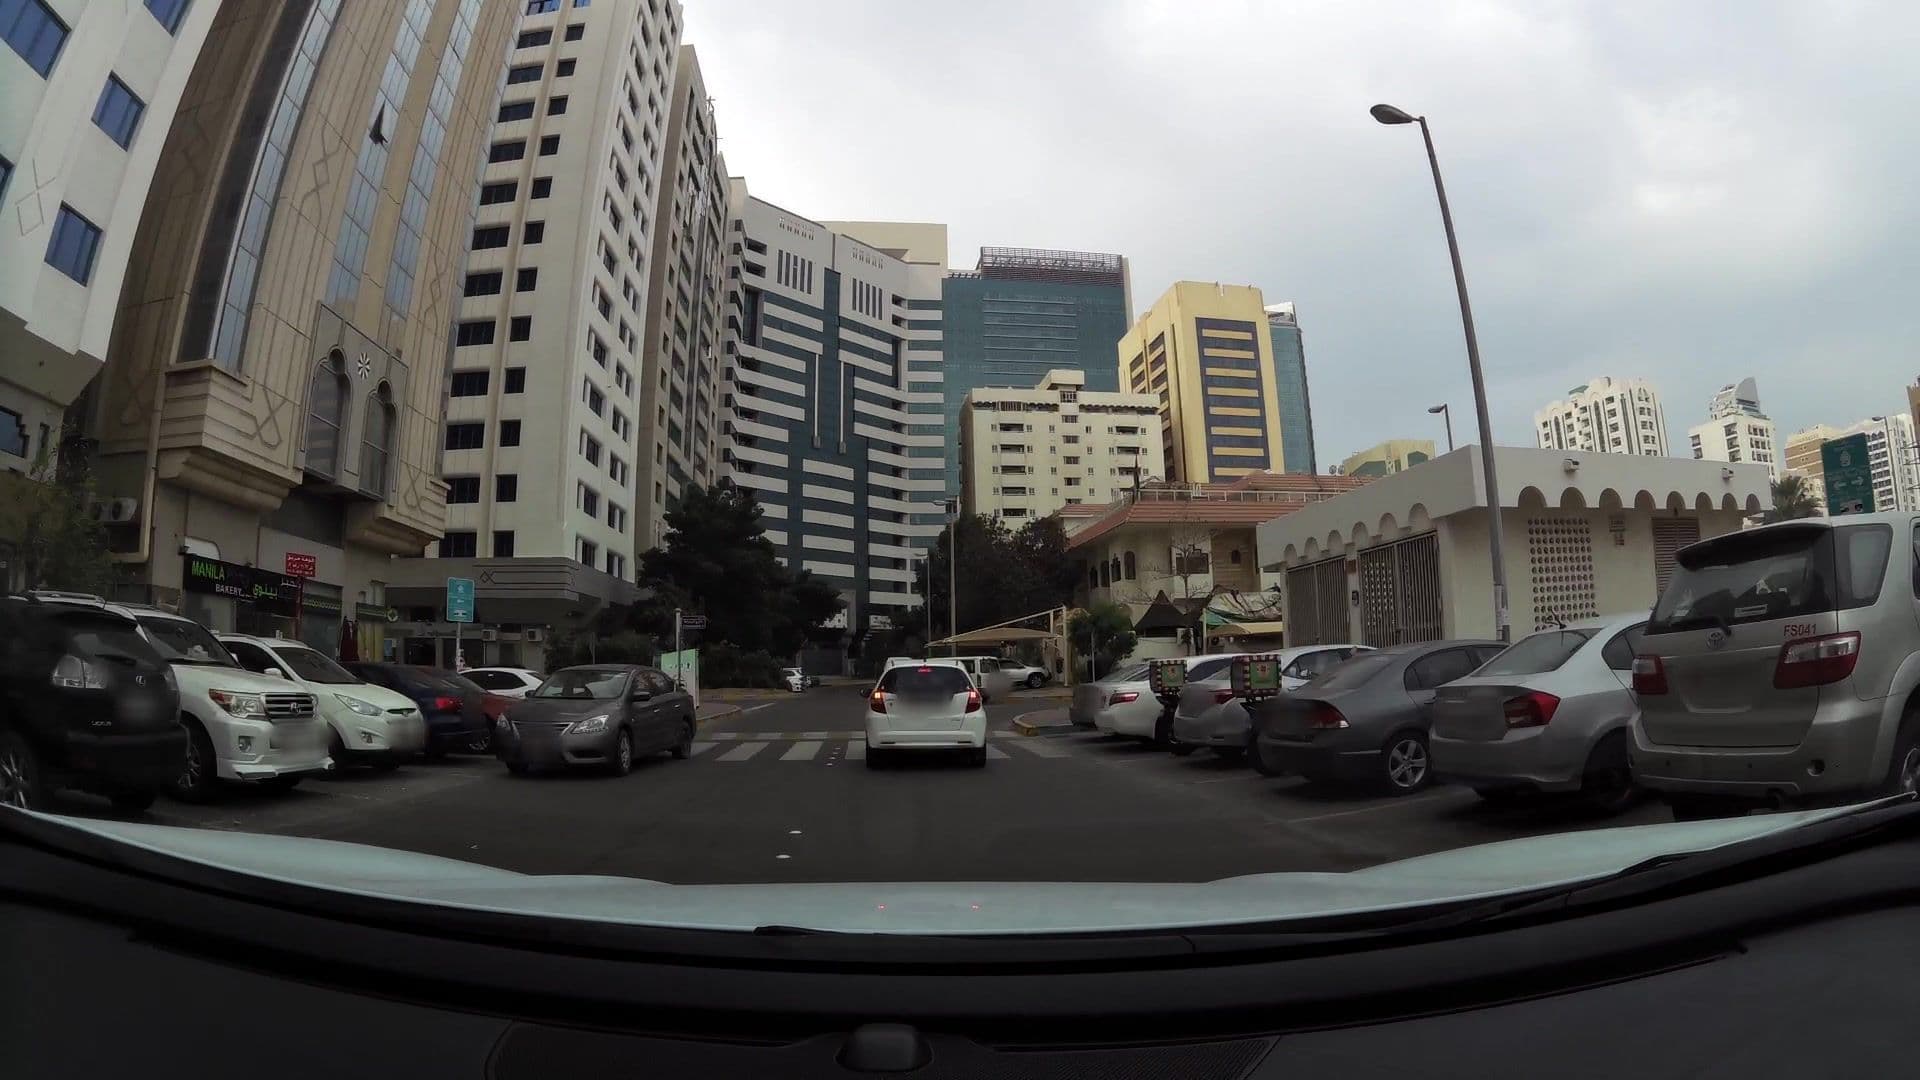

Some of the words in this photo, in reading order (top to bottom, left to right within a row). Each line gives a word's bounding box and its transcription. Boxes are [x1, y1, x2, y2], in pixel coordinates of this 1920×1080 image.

[192, 561, 225, 581] MANILA
[215, 583, 242, 596] BAKERY
[1784, 624, 1817, 636] FS041
